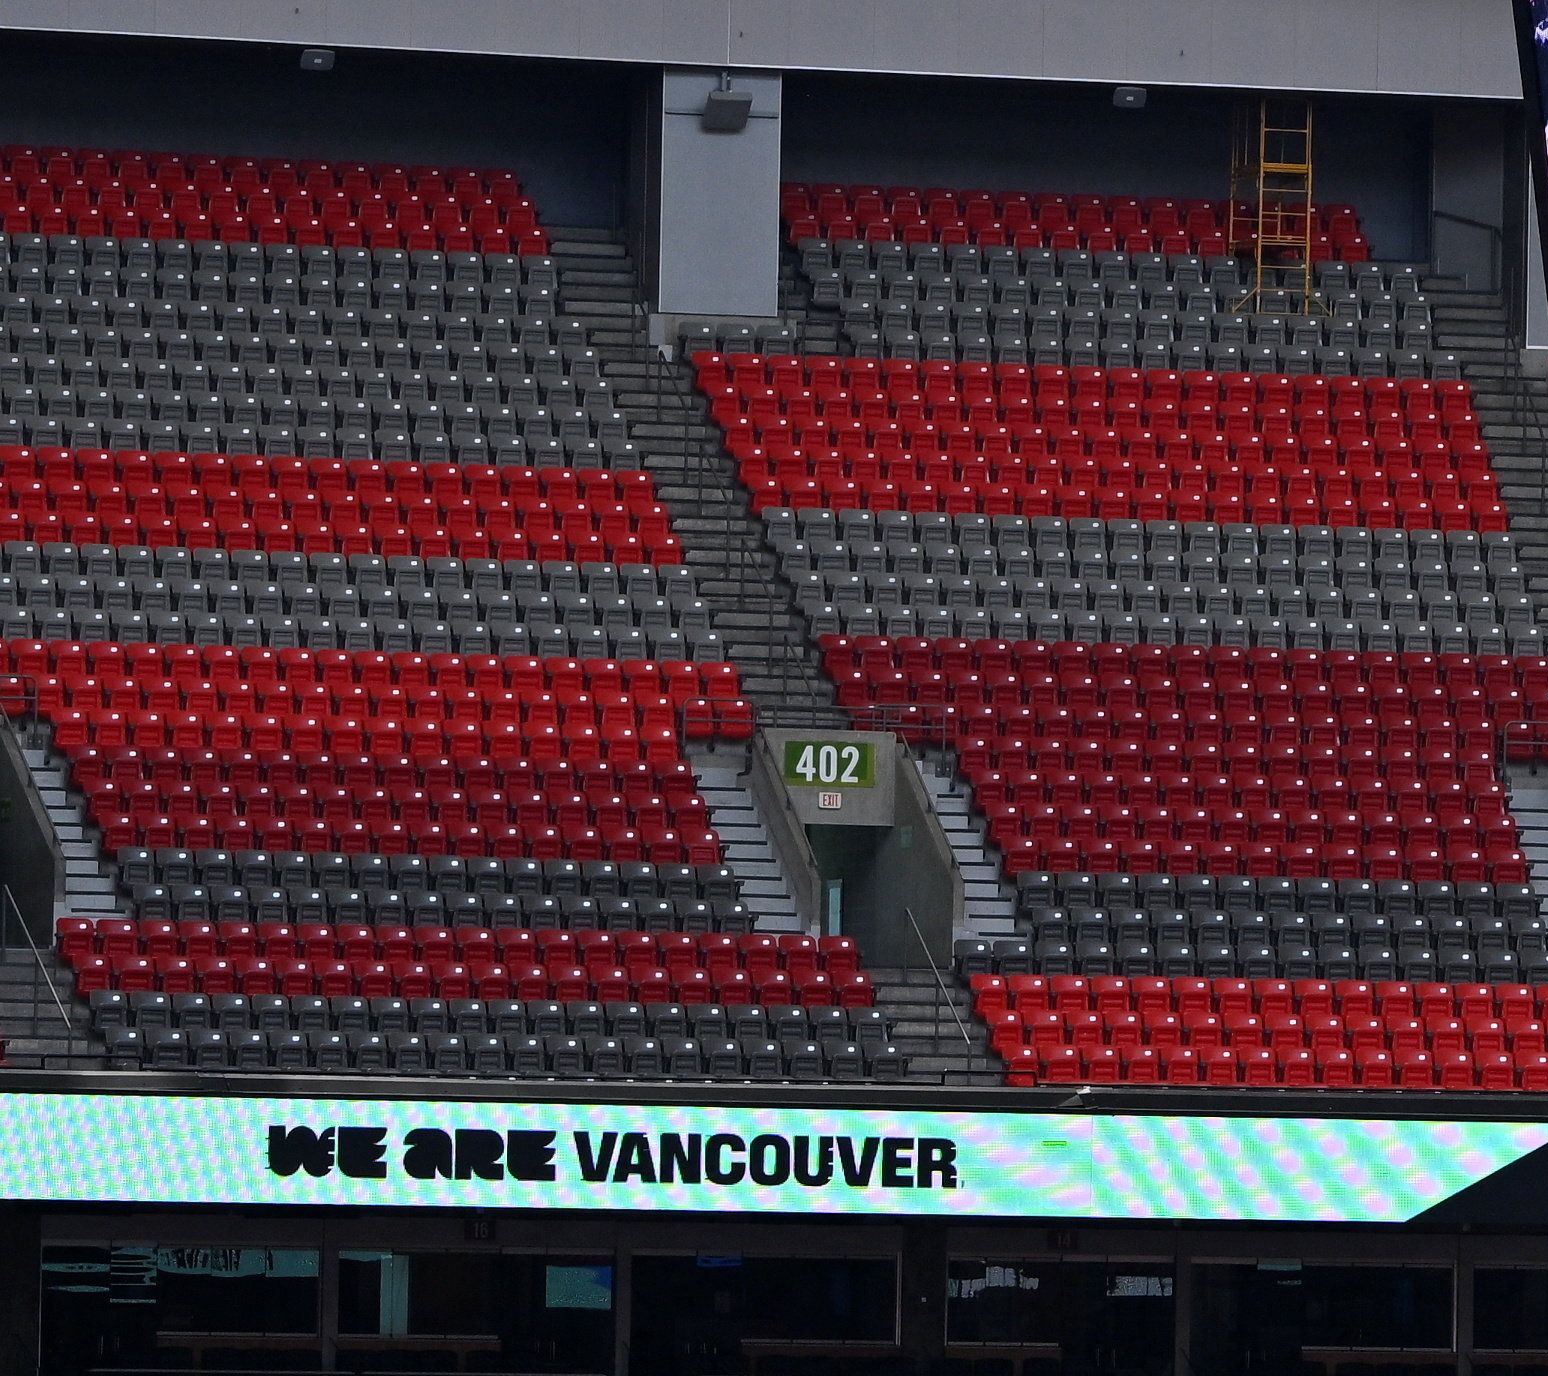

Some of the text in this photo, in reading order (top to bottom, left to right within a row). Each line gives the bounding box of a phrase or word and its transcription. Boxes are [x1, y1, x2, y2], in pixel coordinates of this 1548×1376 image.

[797, 746, 858, 782] 402
[823, 793, 840, 807] EXIT
[266, 1126, 387, 1178] WE
[574, 1132, 956, 1188] VANCOUVER
